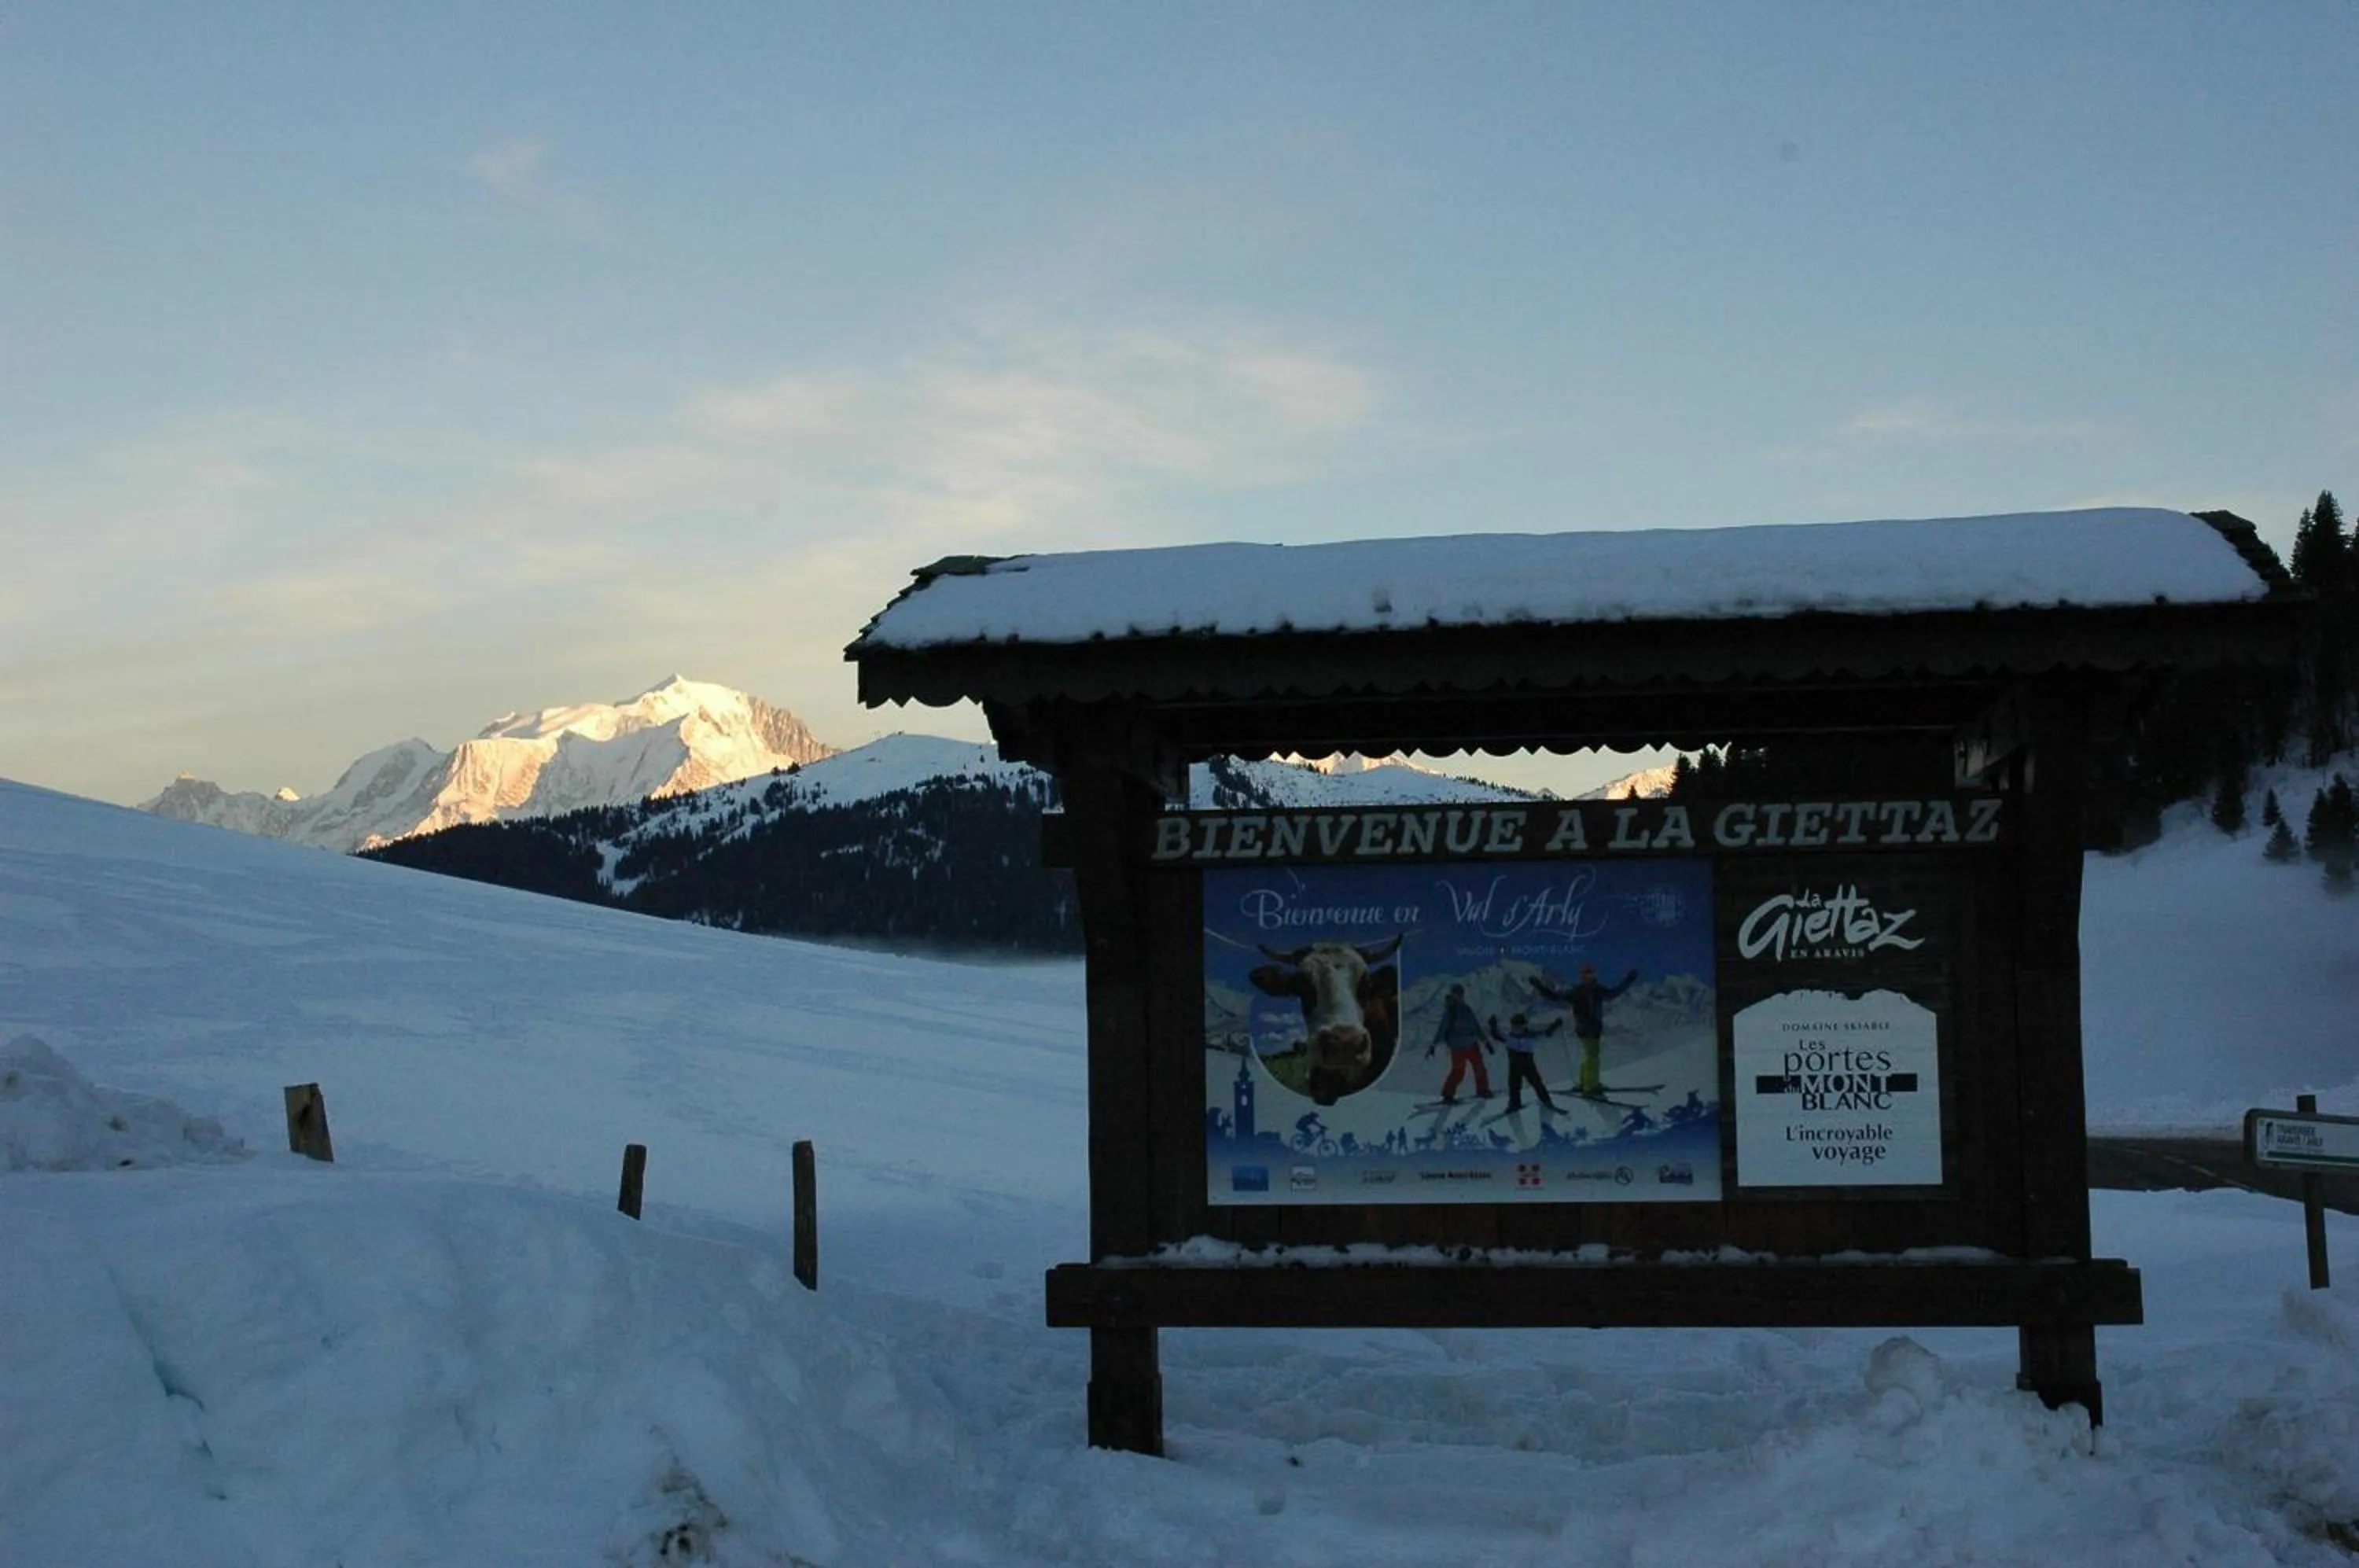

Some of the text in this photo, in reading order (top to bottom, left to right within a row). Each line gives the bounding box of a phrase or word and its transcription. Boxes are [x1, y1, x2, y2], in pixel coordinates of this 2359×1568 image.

[1151, 799, 2003, 860] BIENVENUE A LA GIETTAZ
[1240, 884, 1387, 929] Bienvenue
[1435, 874, 1509, 923] Val
[1795, 887, 1822, 908] La
[1738, 883, 1926, 962] Giettaz
[1782, 1021, 1890, 1032] DOMAINE SKIABLE
[1799, 1039, 1826, 1051] Les
[1783, 1046, 1892, 1077] portes
[1801, 1074, 1893, 1094] MONT
[1801, 1092, 1893, 1111] BLANC
[1786, 1124, 1893, 1143] L'incroyable
[1812, 1144, 1887, 1166] voyage
